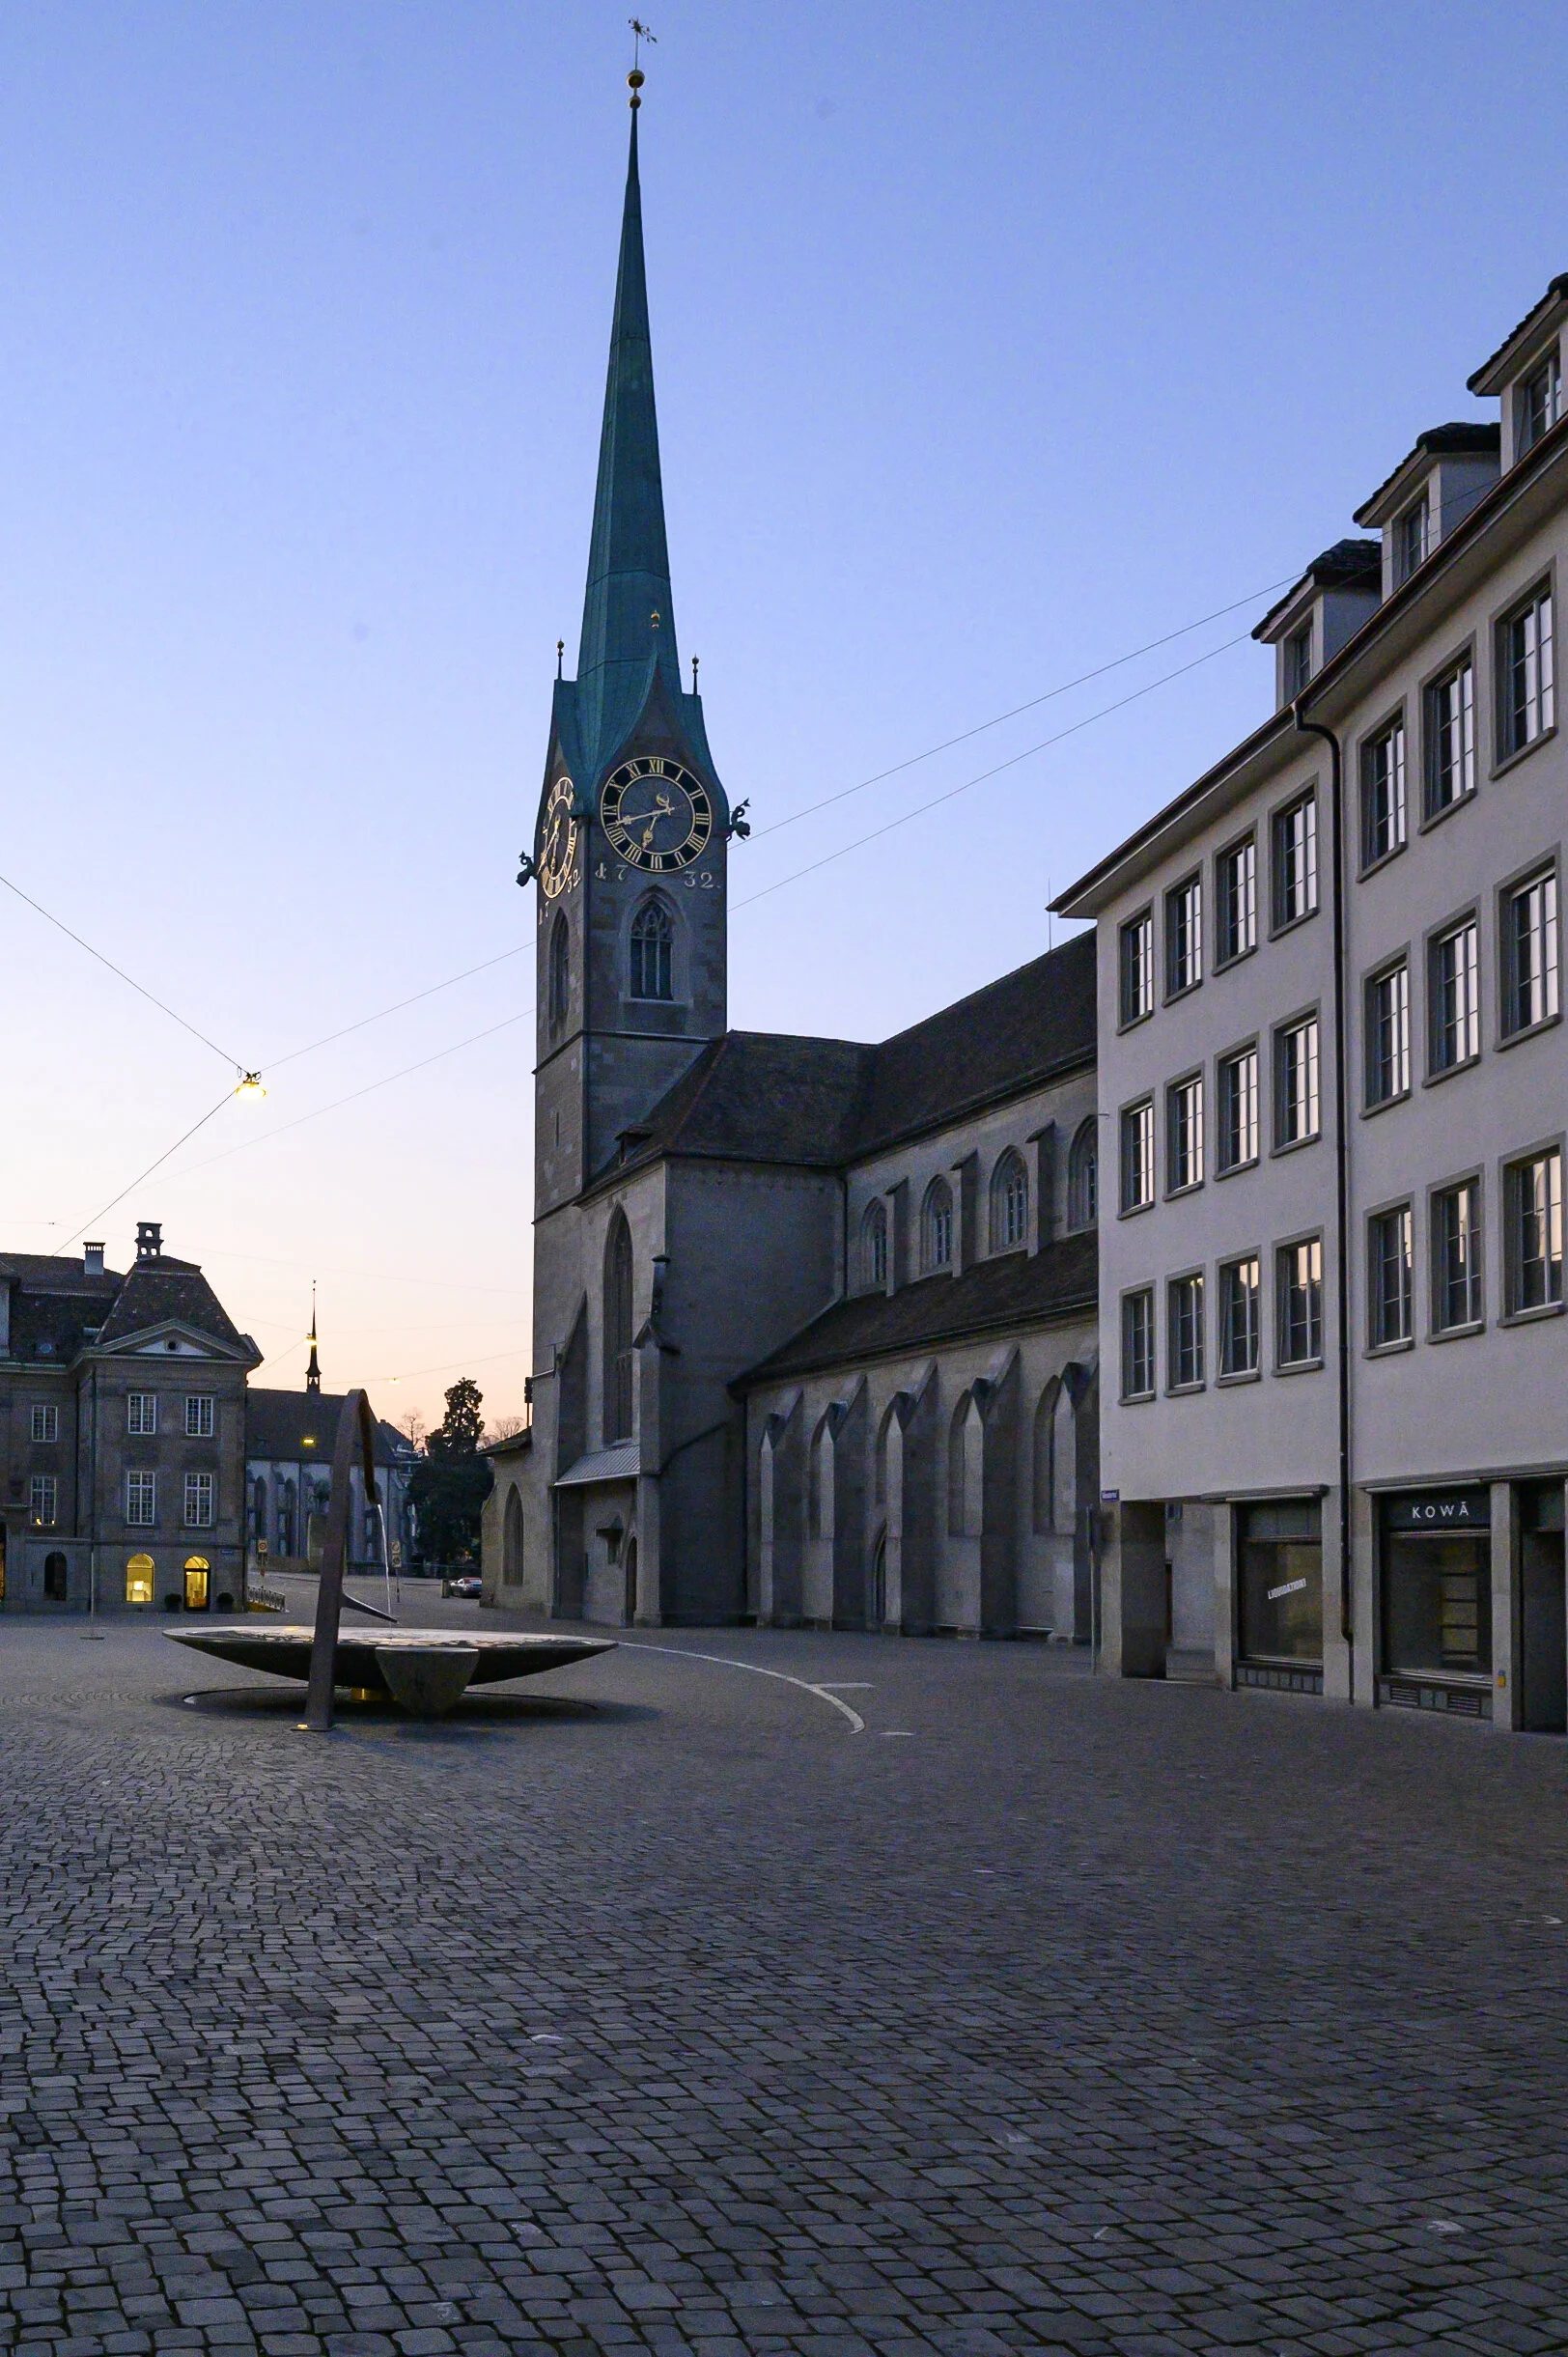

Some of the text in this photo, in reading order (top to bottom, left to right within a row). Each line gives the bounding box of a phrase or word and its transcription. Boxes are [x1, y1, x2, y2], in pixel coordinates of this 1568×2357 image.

[625, 762, 641, 779] XI
[648, 759, 664, 774] XII
[1412, 1501, 1470, 1519] KOWĀ
